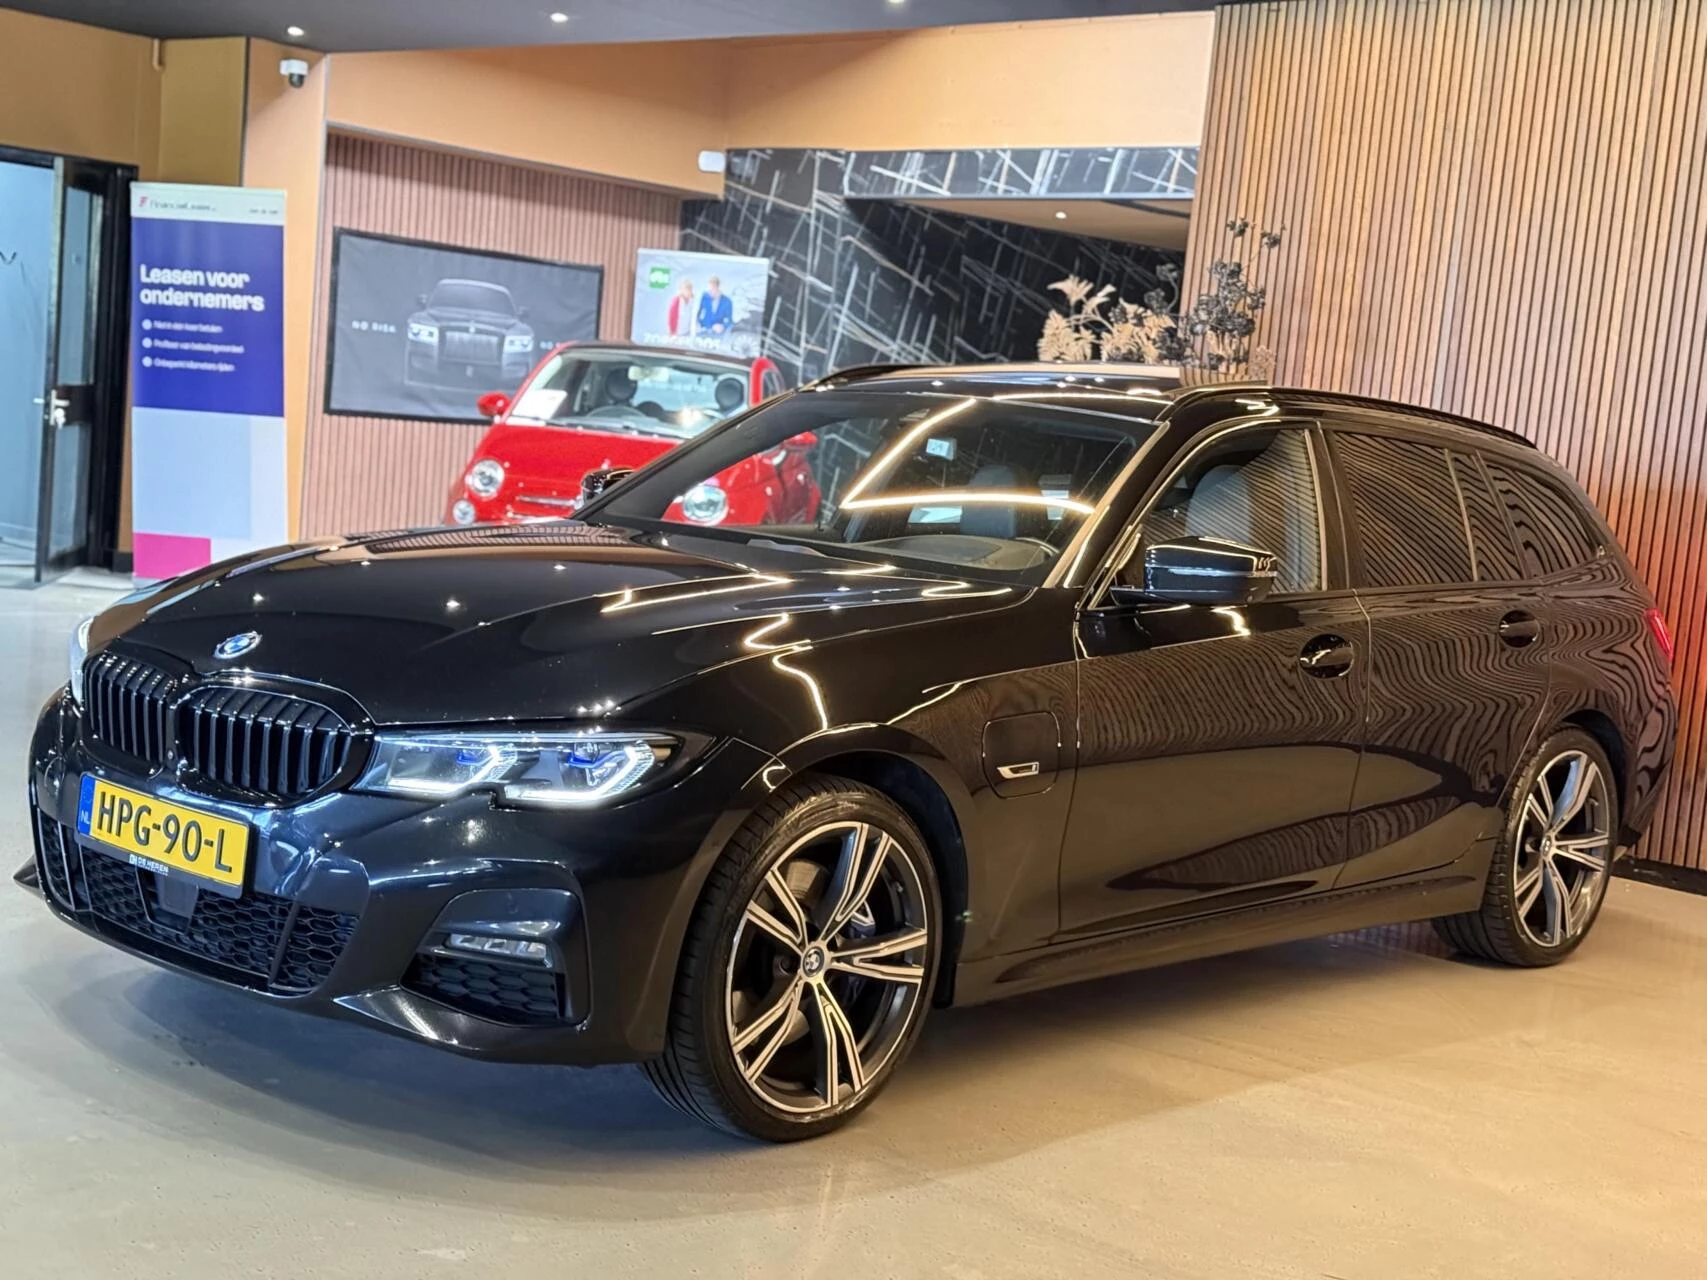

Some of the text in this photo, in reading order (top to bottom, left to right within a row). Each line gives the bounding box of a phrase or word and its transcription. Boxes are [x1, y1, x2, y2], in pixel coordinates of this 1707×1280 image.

[140, 264, 250, 289] Leasen voor
[140, 287, 265, 312] ondernemers
[352, 320, 369, 330] NO
[80, 811, 90, 825] NL
[97, 791, 232, 873] HPG-90-L
